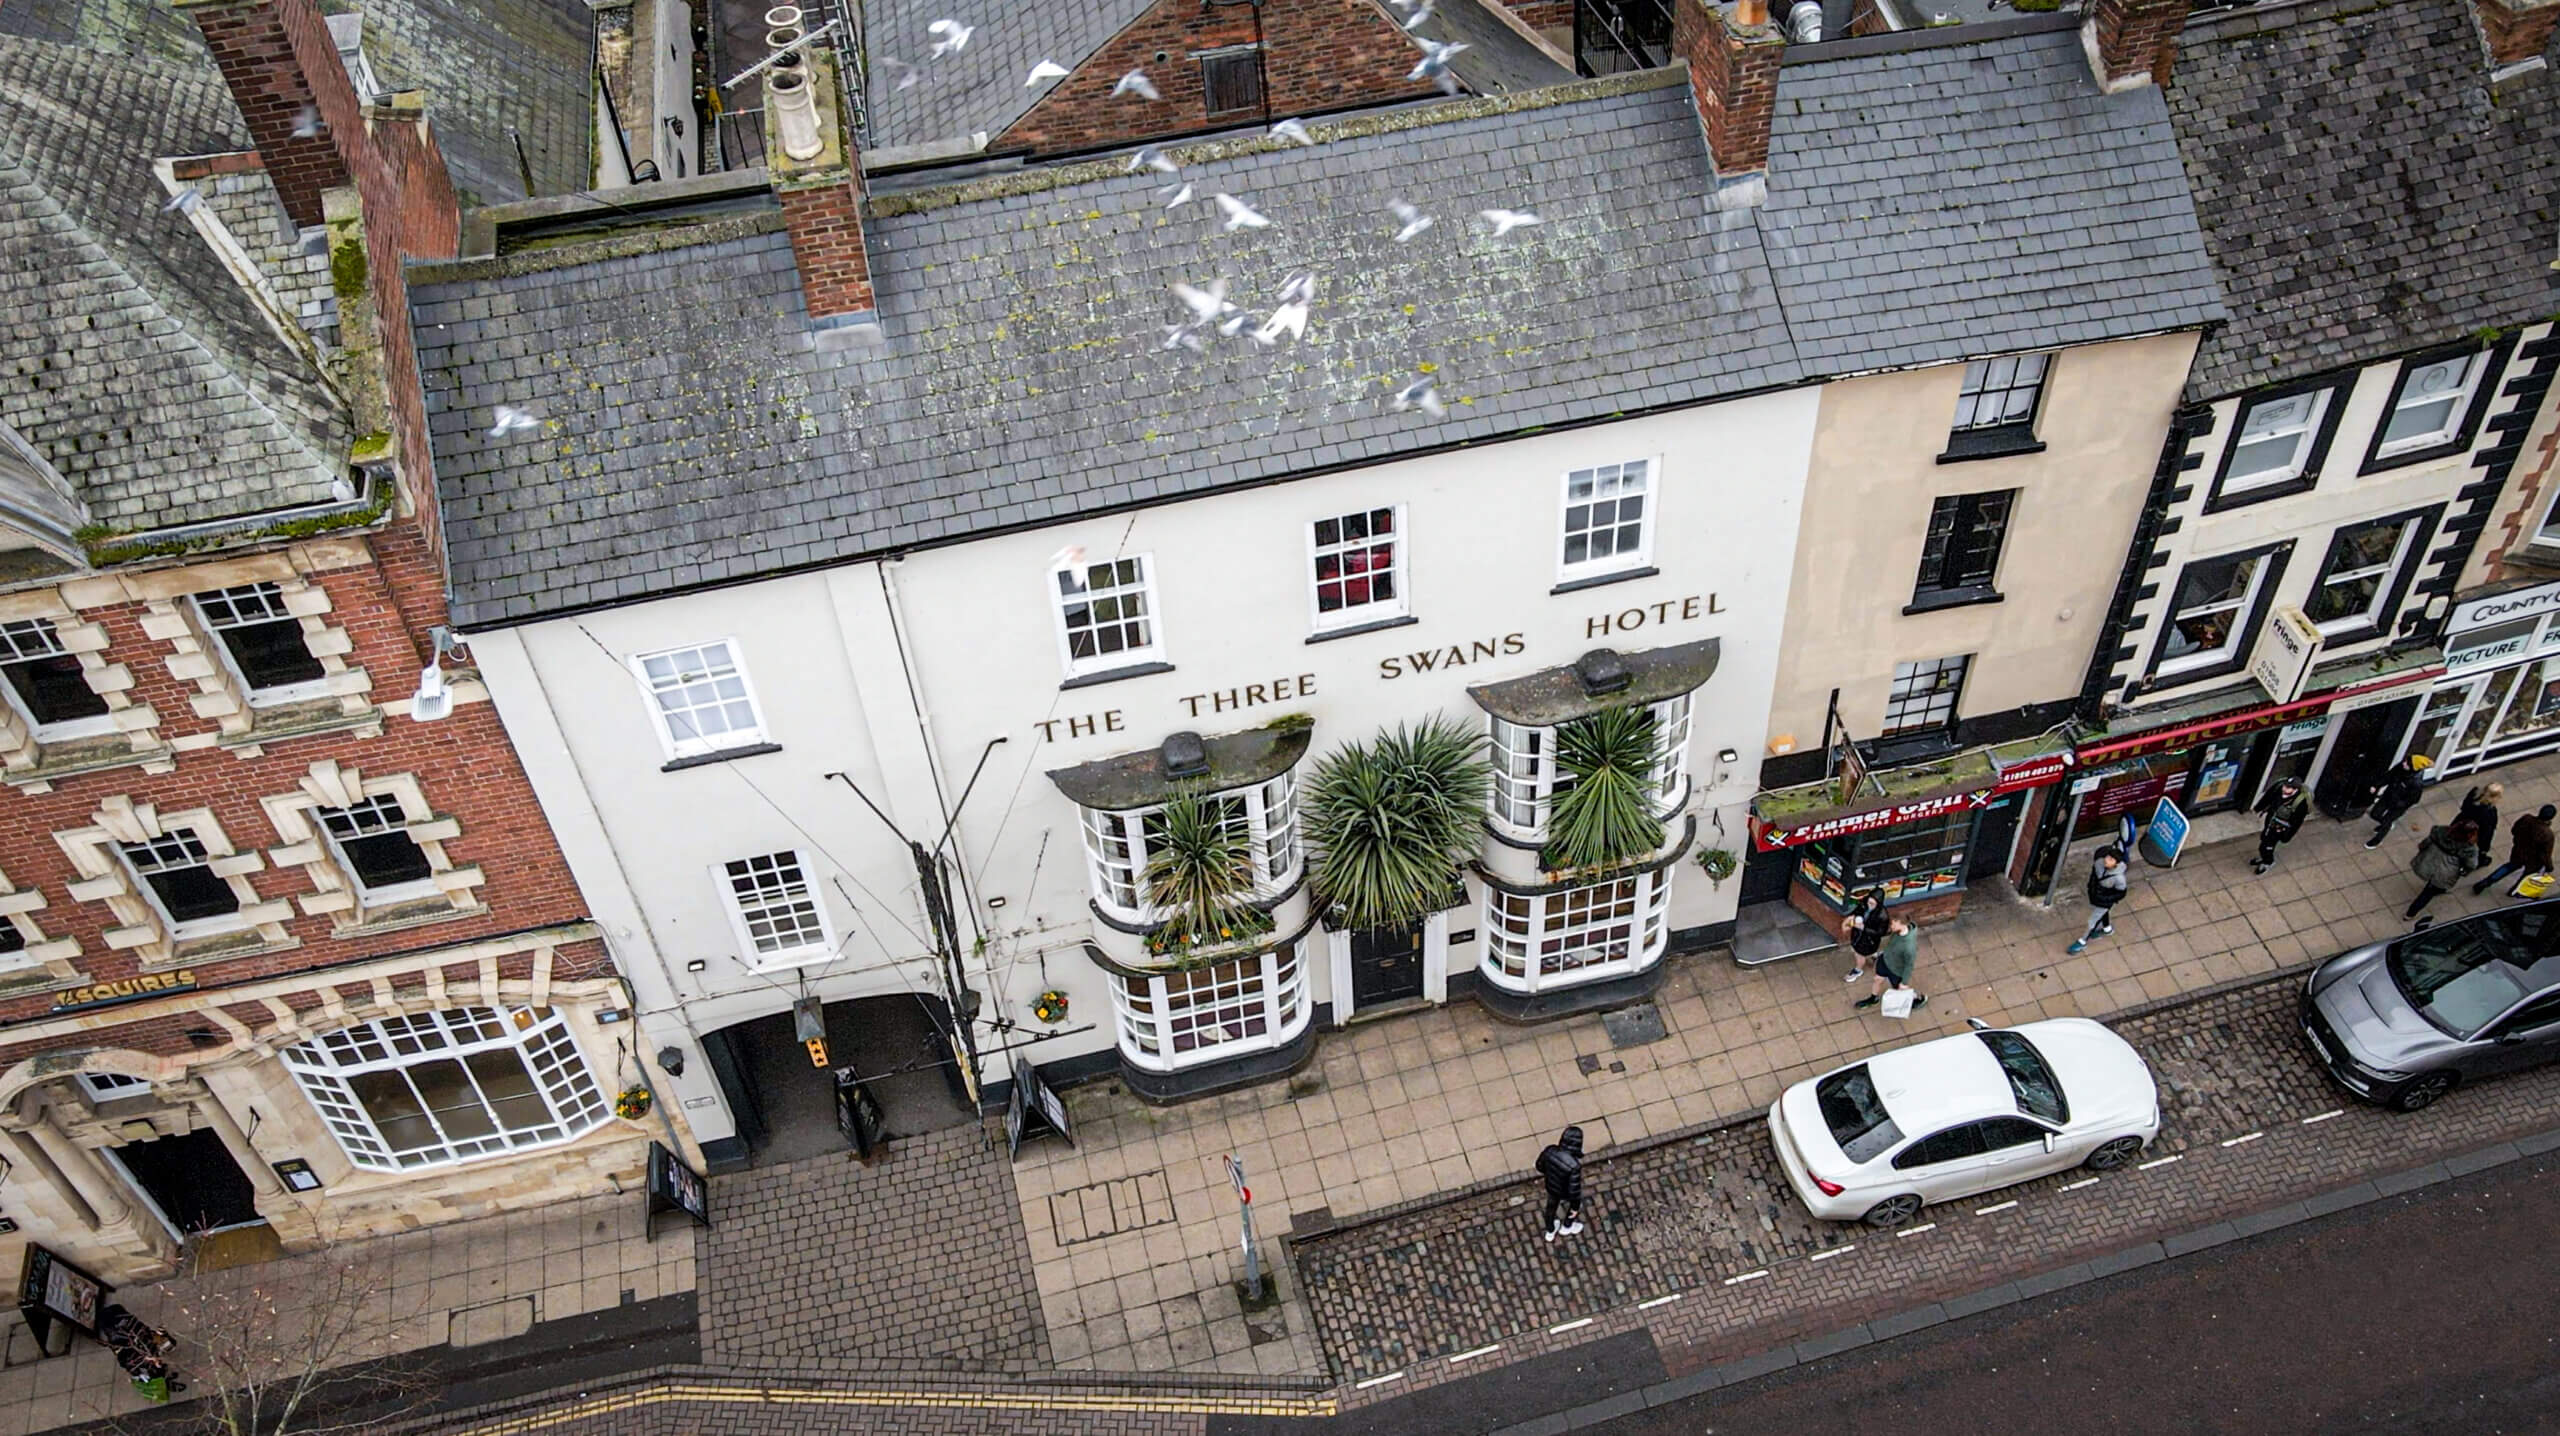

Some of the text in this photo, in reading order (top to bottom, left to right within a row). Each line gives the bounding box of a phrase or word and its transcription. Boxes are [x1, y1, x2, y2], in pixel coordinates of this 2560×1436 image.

[2472, 592, 2554, 622] COUNTY
[2273, 618, 2300, 654] Fringe
[1034, 592, 1727, 744] THE THREE SWANS HOTEL
[2446, 640, 2521, 668] PICTURE
[1805, 807, 1945, 841] KEBABS PIZZAS BURGERS
[56, 970, 196, 1006] ESQUIRES
